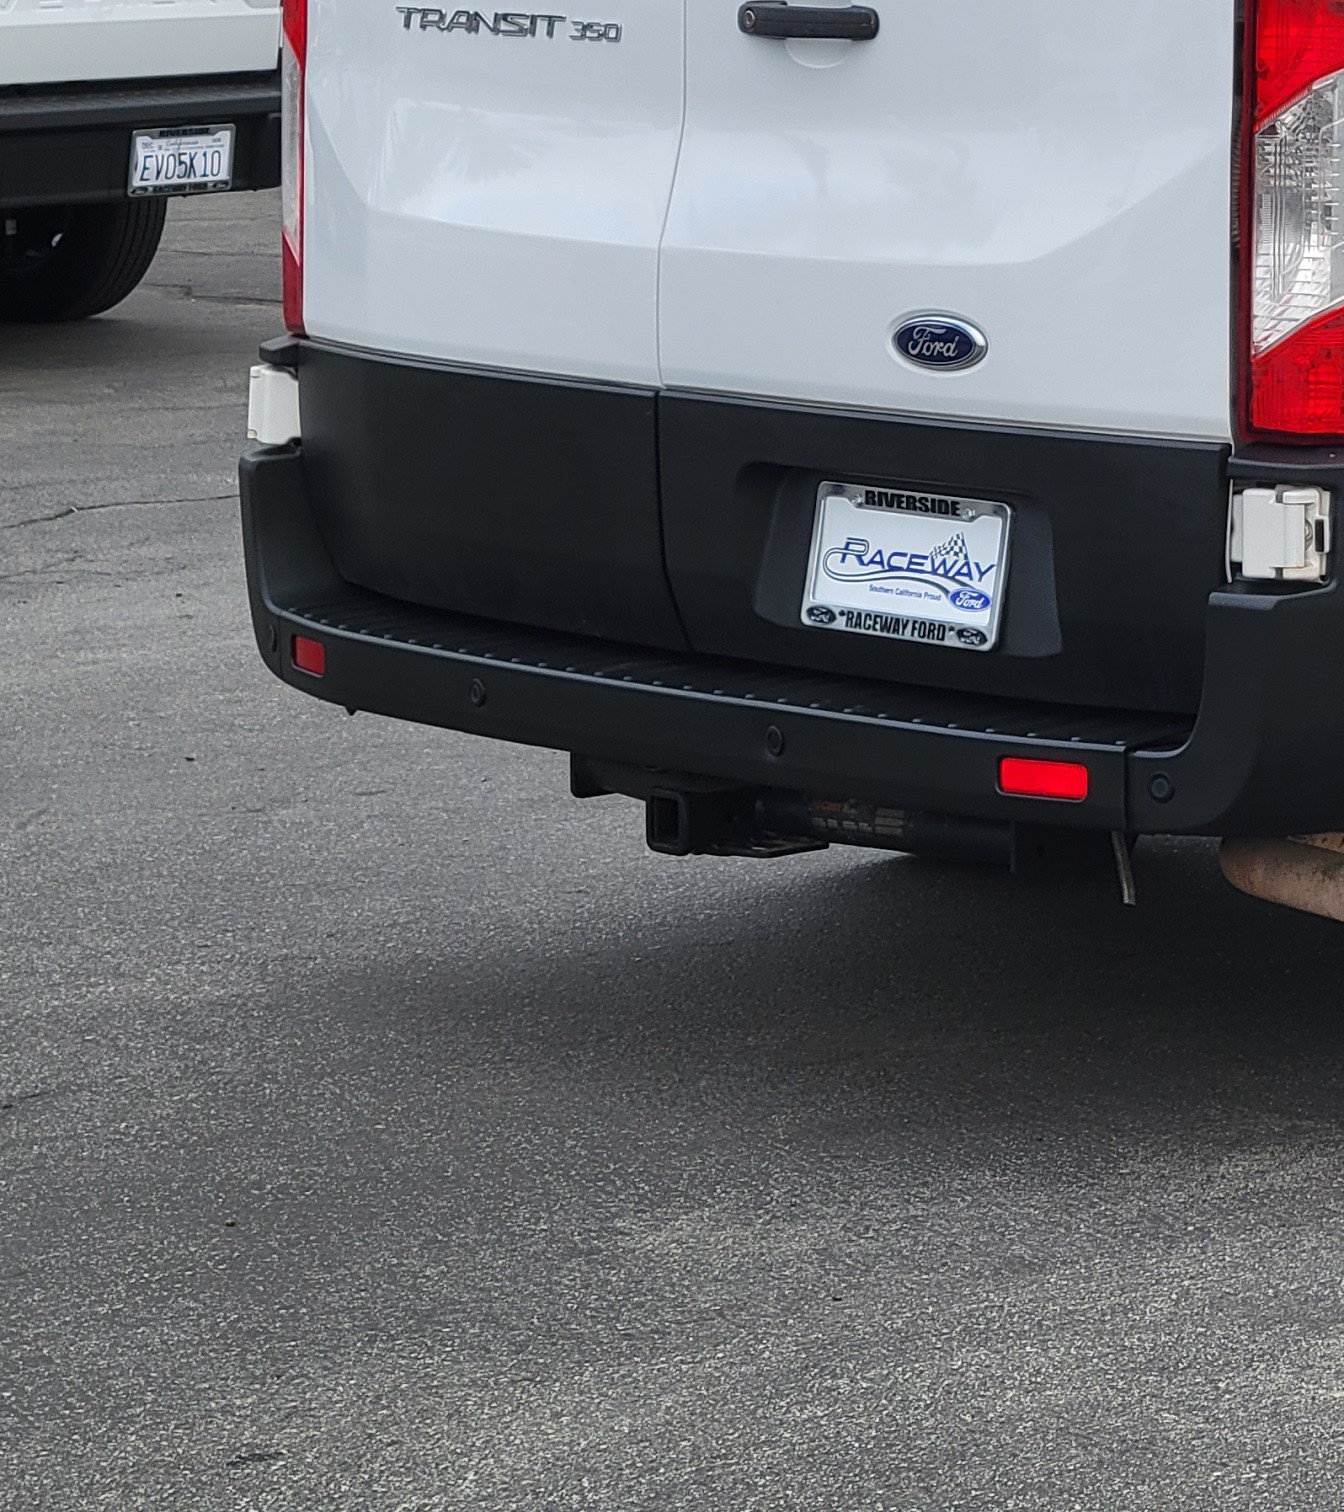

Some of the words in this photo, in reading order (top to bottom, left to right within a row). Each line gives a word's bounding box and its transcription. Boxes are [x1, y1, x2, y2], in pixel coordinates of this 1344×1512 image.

[396, 6, 567, 39] TRANSIT
[568, 20, 622, 43] 350
[907, 326, 960, 358] Ford
[864, 489, 962, 517] RIVERSIDE
[838, 536, 997, 583] RACEWAY
[955, 592, 984, 609] Ford
[844, 610, 910, 638] RACEWAY
[910, 619, 947, 642] FORD
